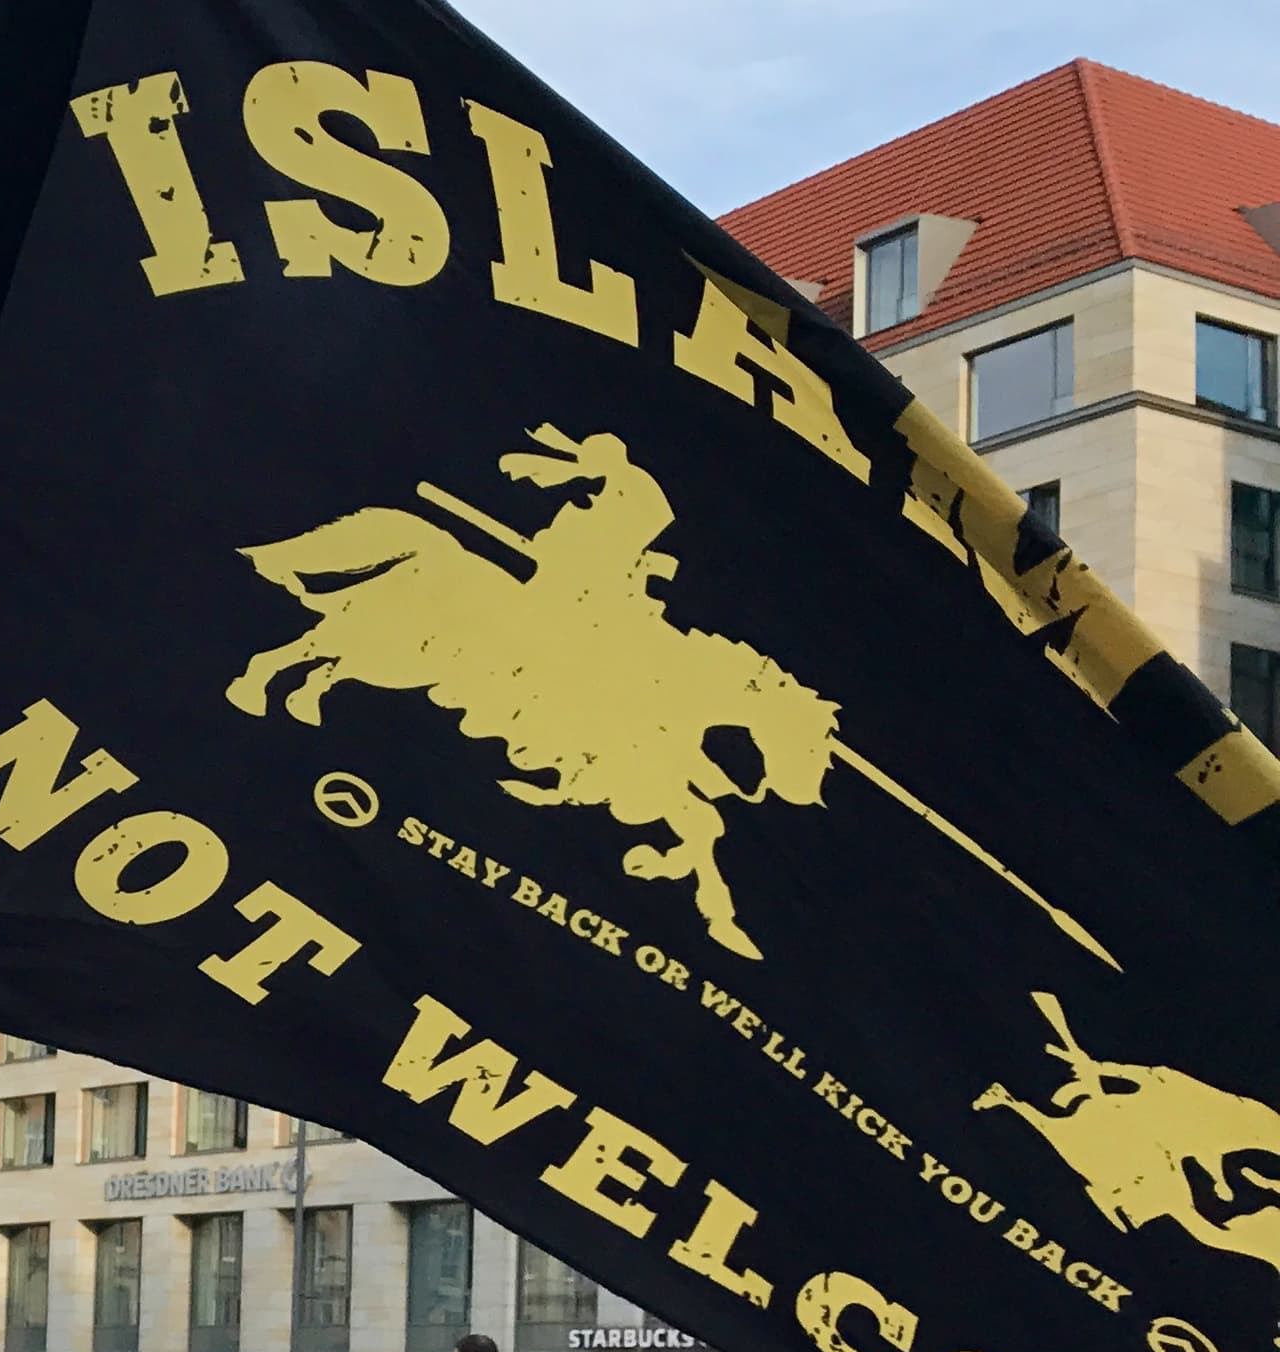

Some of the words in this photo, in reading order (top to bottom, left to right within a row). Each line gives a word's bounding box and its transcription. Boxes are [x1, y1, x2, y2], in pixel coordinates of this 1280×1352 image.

[397, 816, 511, 888] STAY
[511, 876, 629, 956] BACK
[635, 945, 690, 990] OR
[700, 980, 807, 1079] WE'LL
[813, 1071, 912, 1160] KICK
[919, 1153, 1006, 1224] YOU
[1003, 1218, 1132, 1312] BACK
[104, 1168, 213, 1200] DRESDNER
[214, 1162, 280, 1194] BANK
[568, 1328, 695, 1350] STARBUCKS
